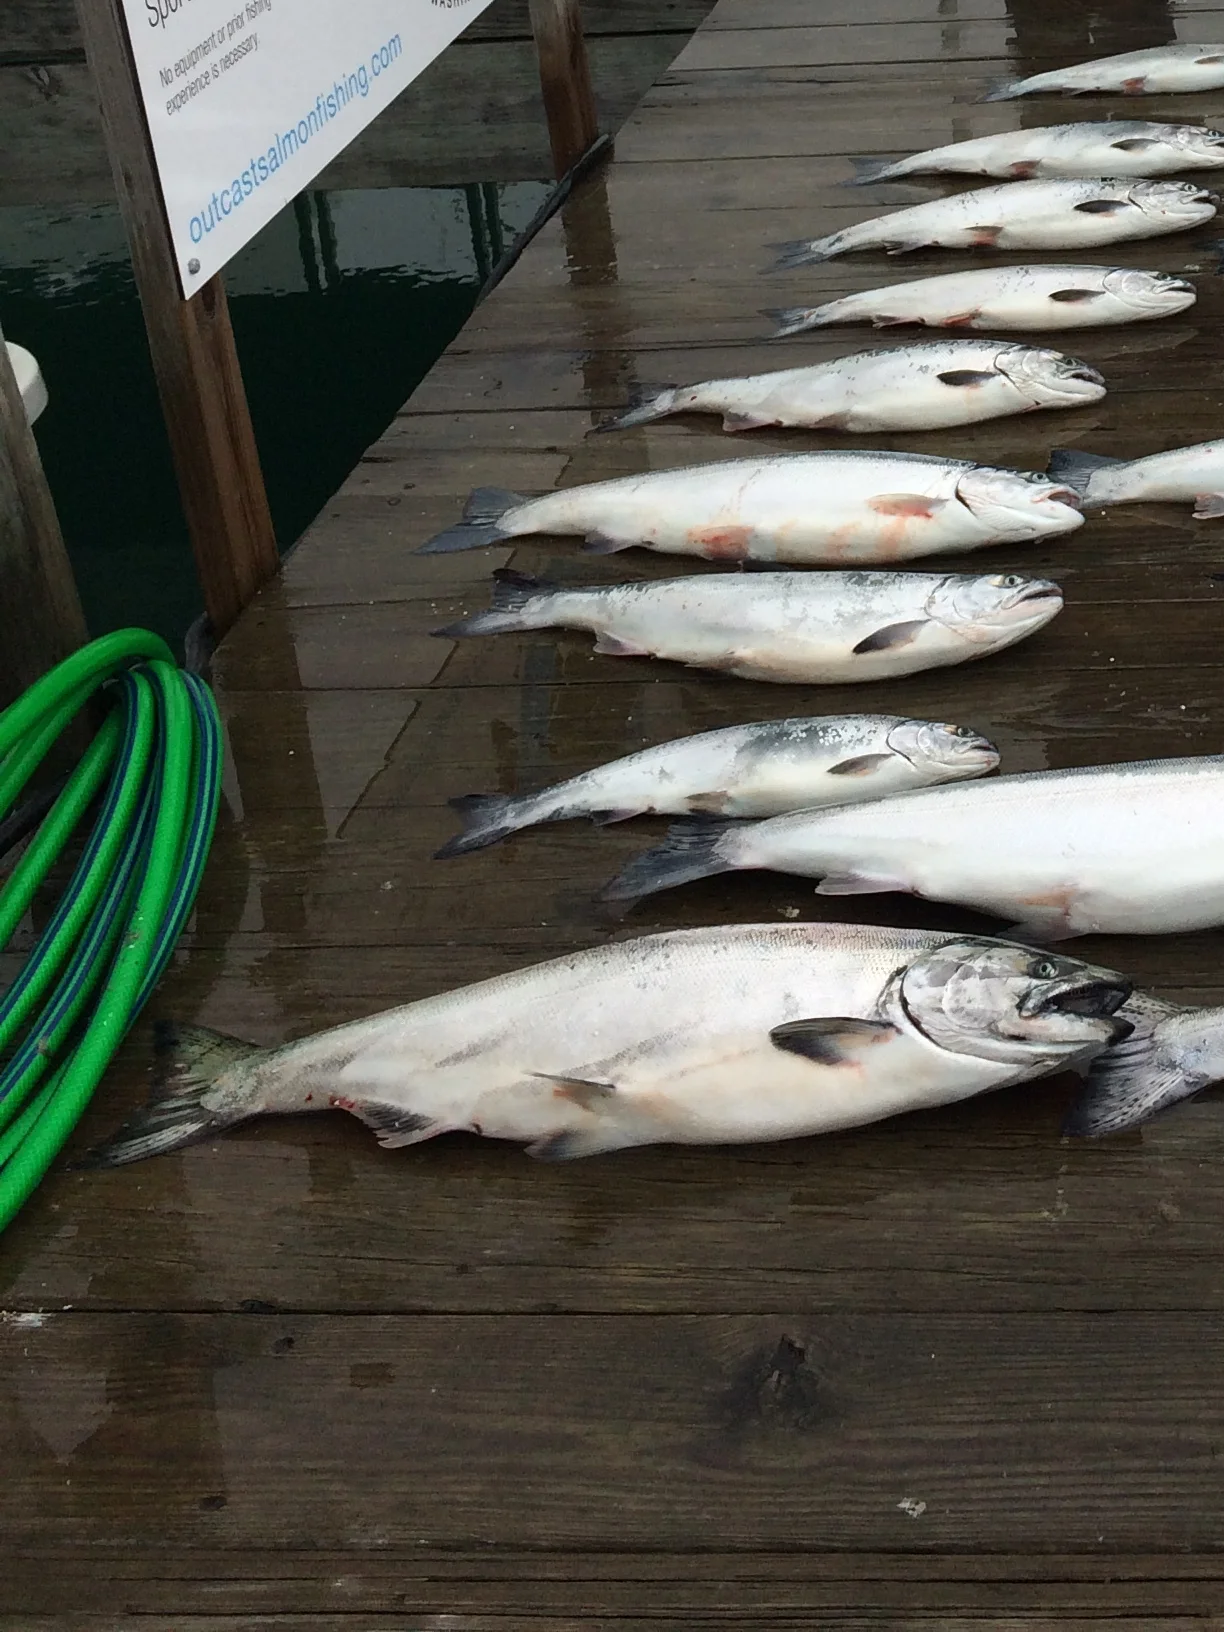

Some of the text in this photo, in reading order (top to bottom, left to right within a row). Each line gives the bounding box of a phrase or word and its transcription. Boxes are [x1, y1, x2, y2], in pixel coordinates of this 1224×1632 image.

[159, 66, 174, 88] No
[173, 32, 218, 77] equipment
[216, 26, 226, 45] or
[225, 12, 246, 42] prior
[165, 69, 211, 117] experience
[209, 62, 220, 80] is
[188, 33, 403, 244] outcastsalmonfishing.com
